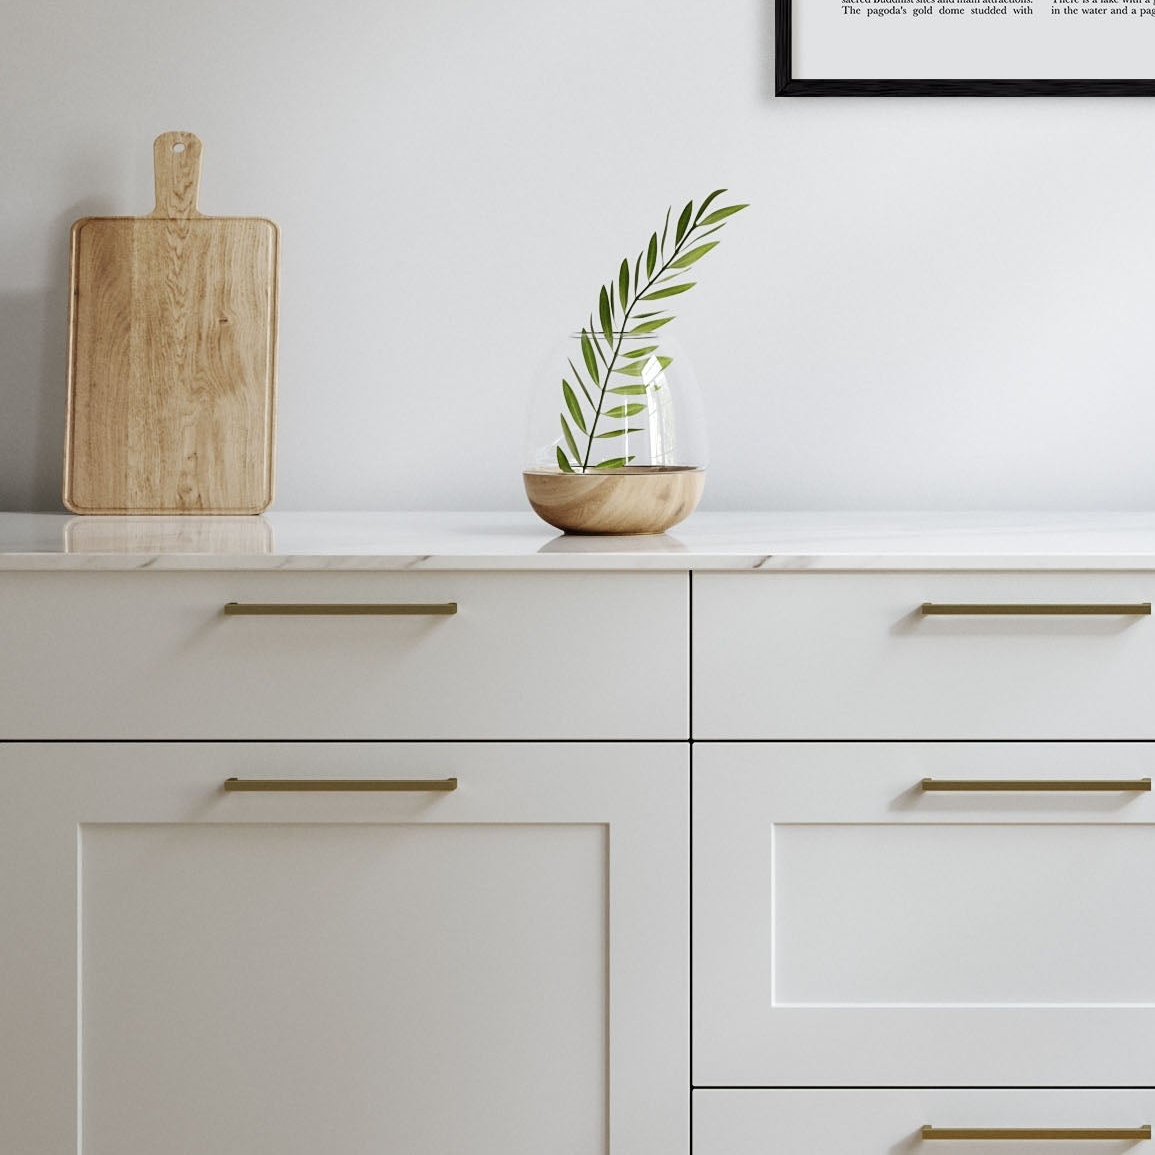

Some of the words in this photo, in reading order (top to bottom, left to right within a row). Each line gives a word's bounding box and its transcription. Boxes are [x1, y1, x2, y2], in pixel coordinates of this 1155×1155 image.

[842, 6, 861, 14] The
[867, 6, 907, 17] pagoda's
[913, 6, 933, 17] gold
[939, 6, 965, 14] dome
[971, 6, 1007, 14] studded
[1013, 6, 1033, 14] with
[1052, 6, 1060, 14] in
[1064, 6, 1078, 14] the
[1111, 6, 1128, 14] and
